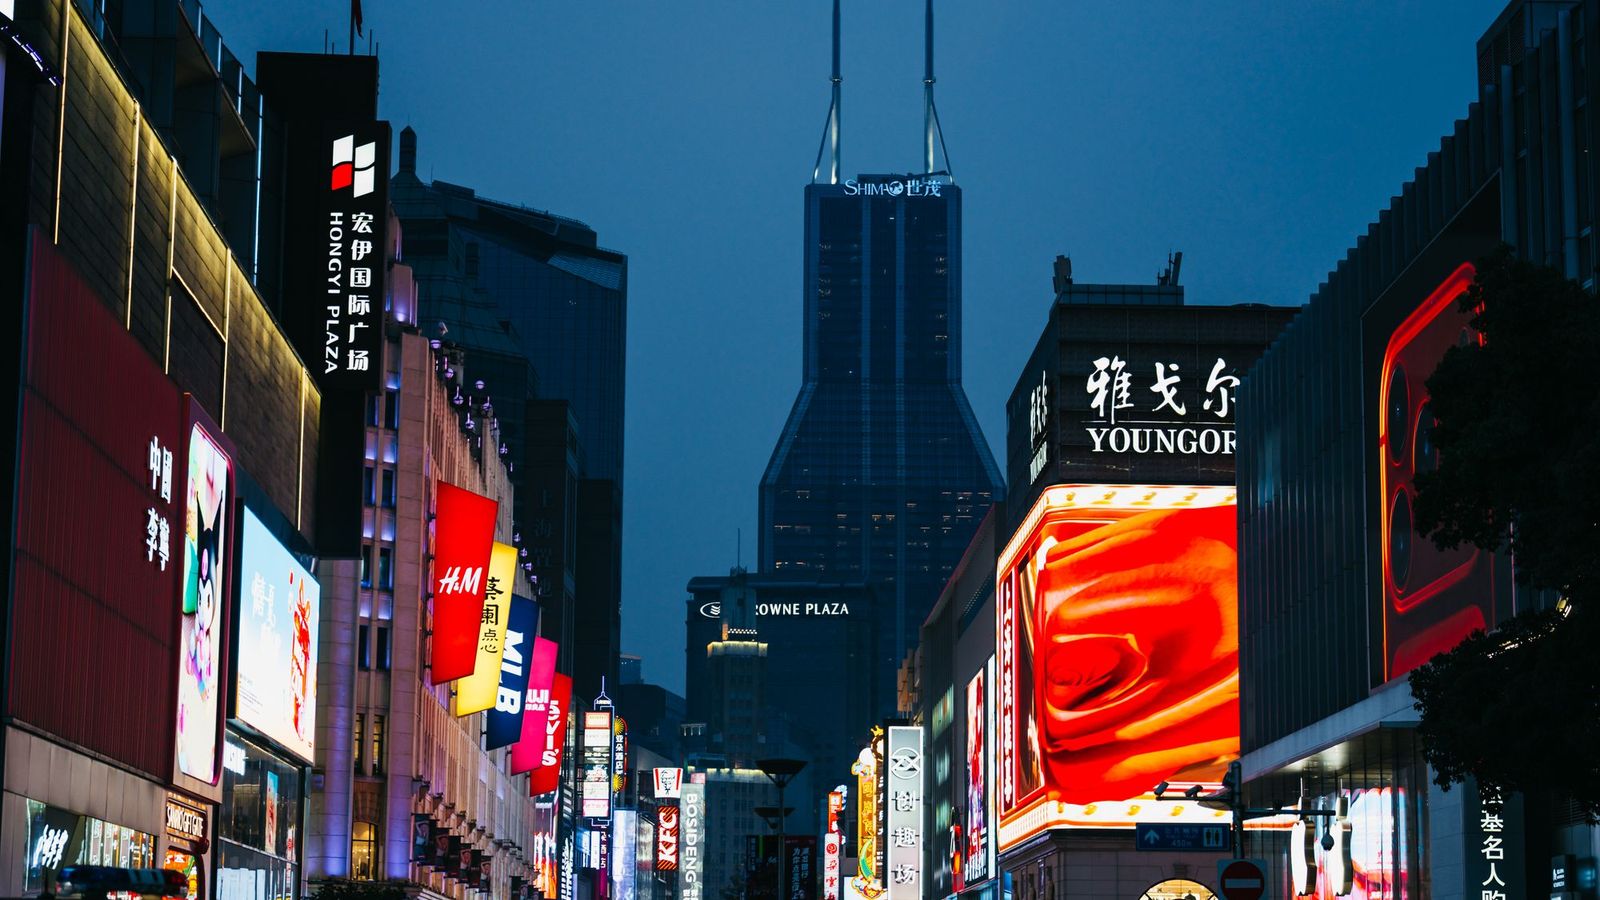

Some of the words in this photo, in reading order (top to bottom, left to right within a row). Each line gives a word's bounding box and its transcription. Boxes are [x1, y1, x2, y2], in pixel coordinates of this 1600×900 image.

[905, 179, 941, 197] 世茂
[327, 212, 344, 294] HONGYI
[346, 211, 374, 372] 宏伊国际广场
[324, 305, 341, 374] PLAZA
[1086, 355, 1241, 425] 雅戈尔
[439, 566, 483, 596] H&M
[805, 603, 849, 615] PLAZA
[495, 629, 524, 715] MLB
[658, 811, 678, 864] KFC
[685, 793, 698, 883] BOSIDENG
[894, 791, 916, 885] 创趣场
